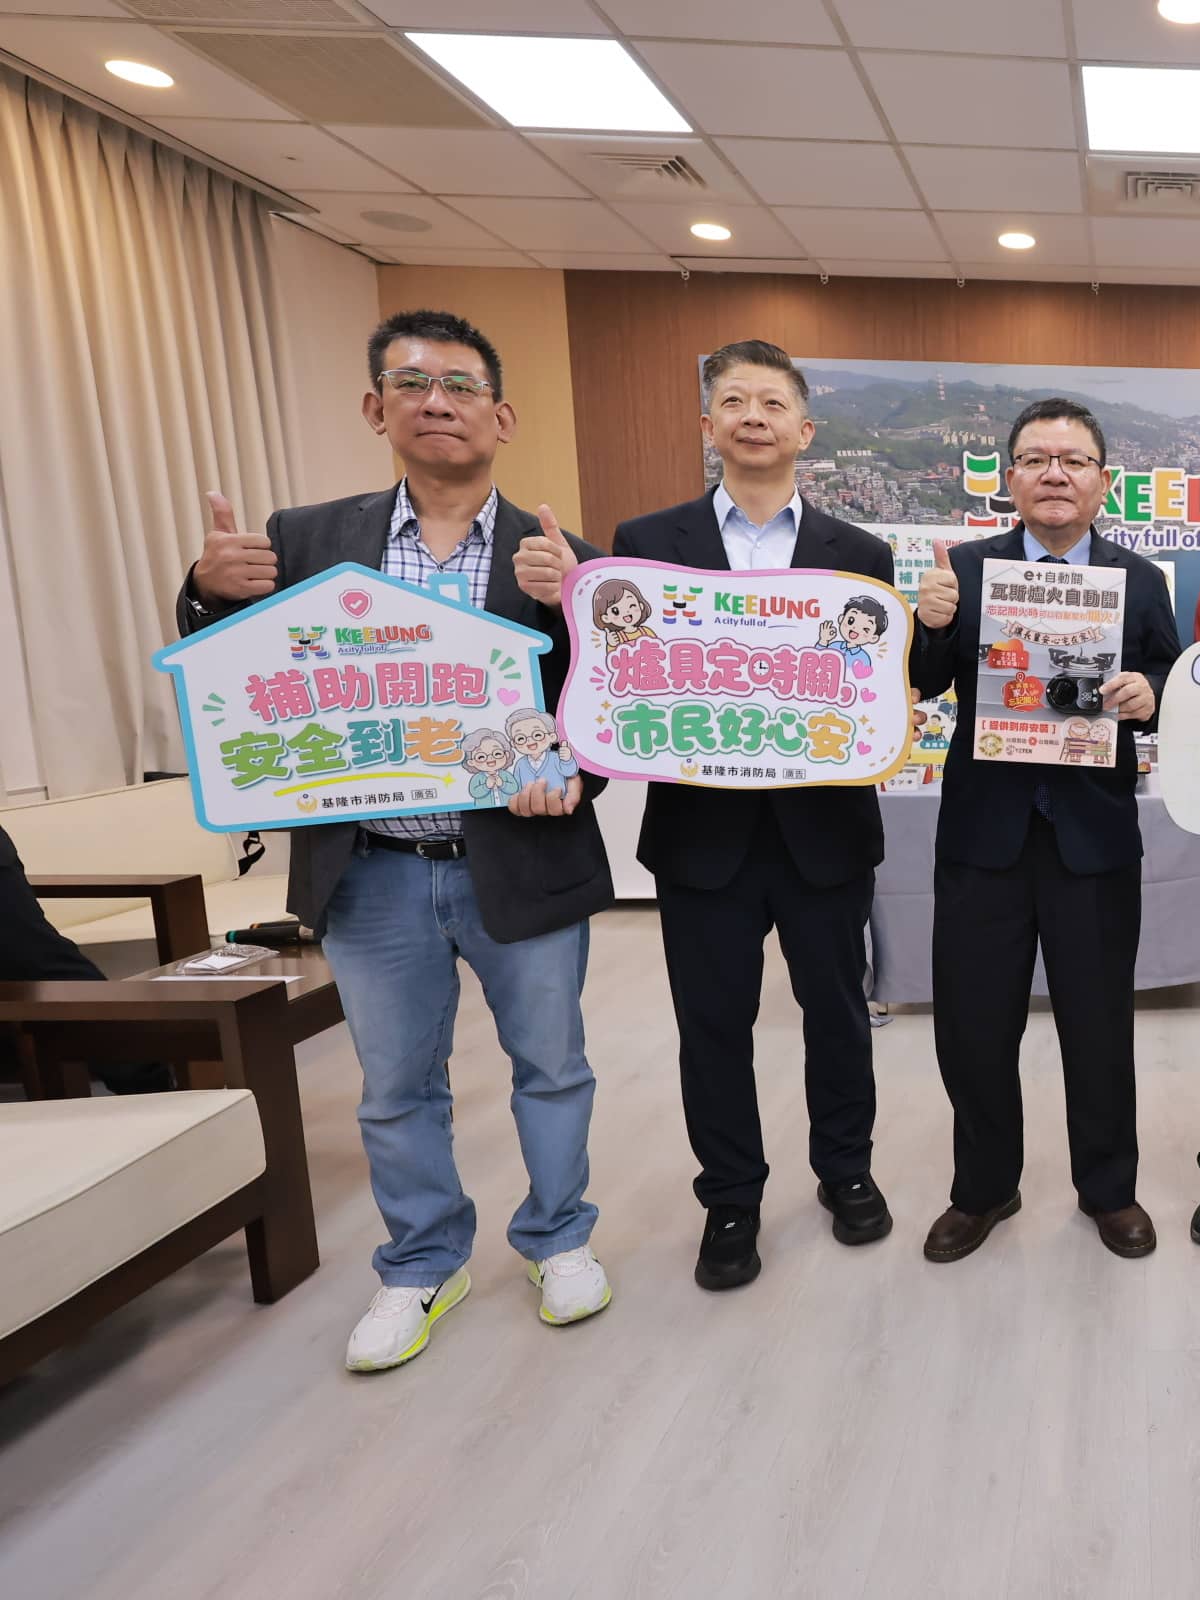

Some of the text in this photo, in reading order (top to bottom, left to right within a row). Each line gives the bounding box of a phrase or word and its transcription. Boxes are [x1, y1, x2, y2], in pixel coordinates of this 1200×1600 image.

[1144, 529, 1177, 547] full
[714, 592, 820, 619] KEELUNG
[990, 583, 1119, 609] 瓦斯爐火自動關
[335, 624, 431, 645] KEELUNG
[714, 617, 767, 628] A city full of
[611, 641, 853, 704] 爐具定時關,
[245, 662, 488, 722] 補助開跑
[616, 704, 849, 761] 市民好心安
[220, 717, 463, 787] 安全到老
[702, 765, 776, 779] 基隆市消防局
[322, 789, 435, 809] 基隆市消防局 廣告
